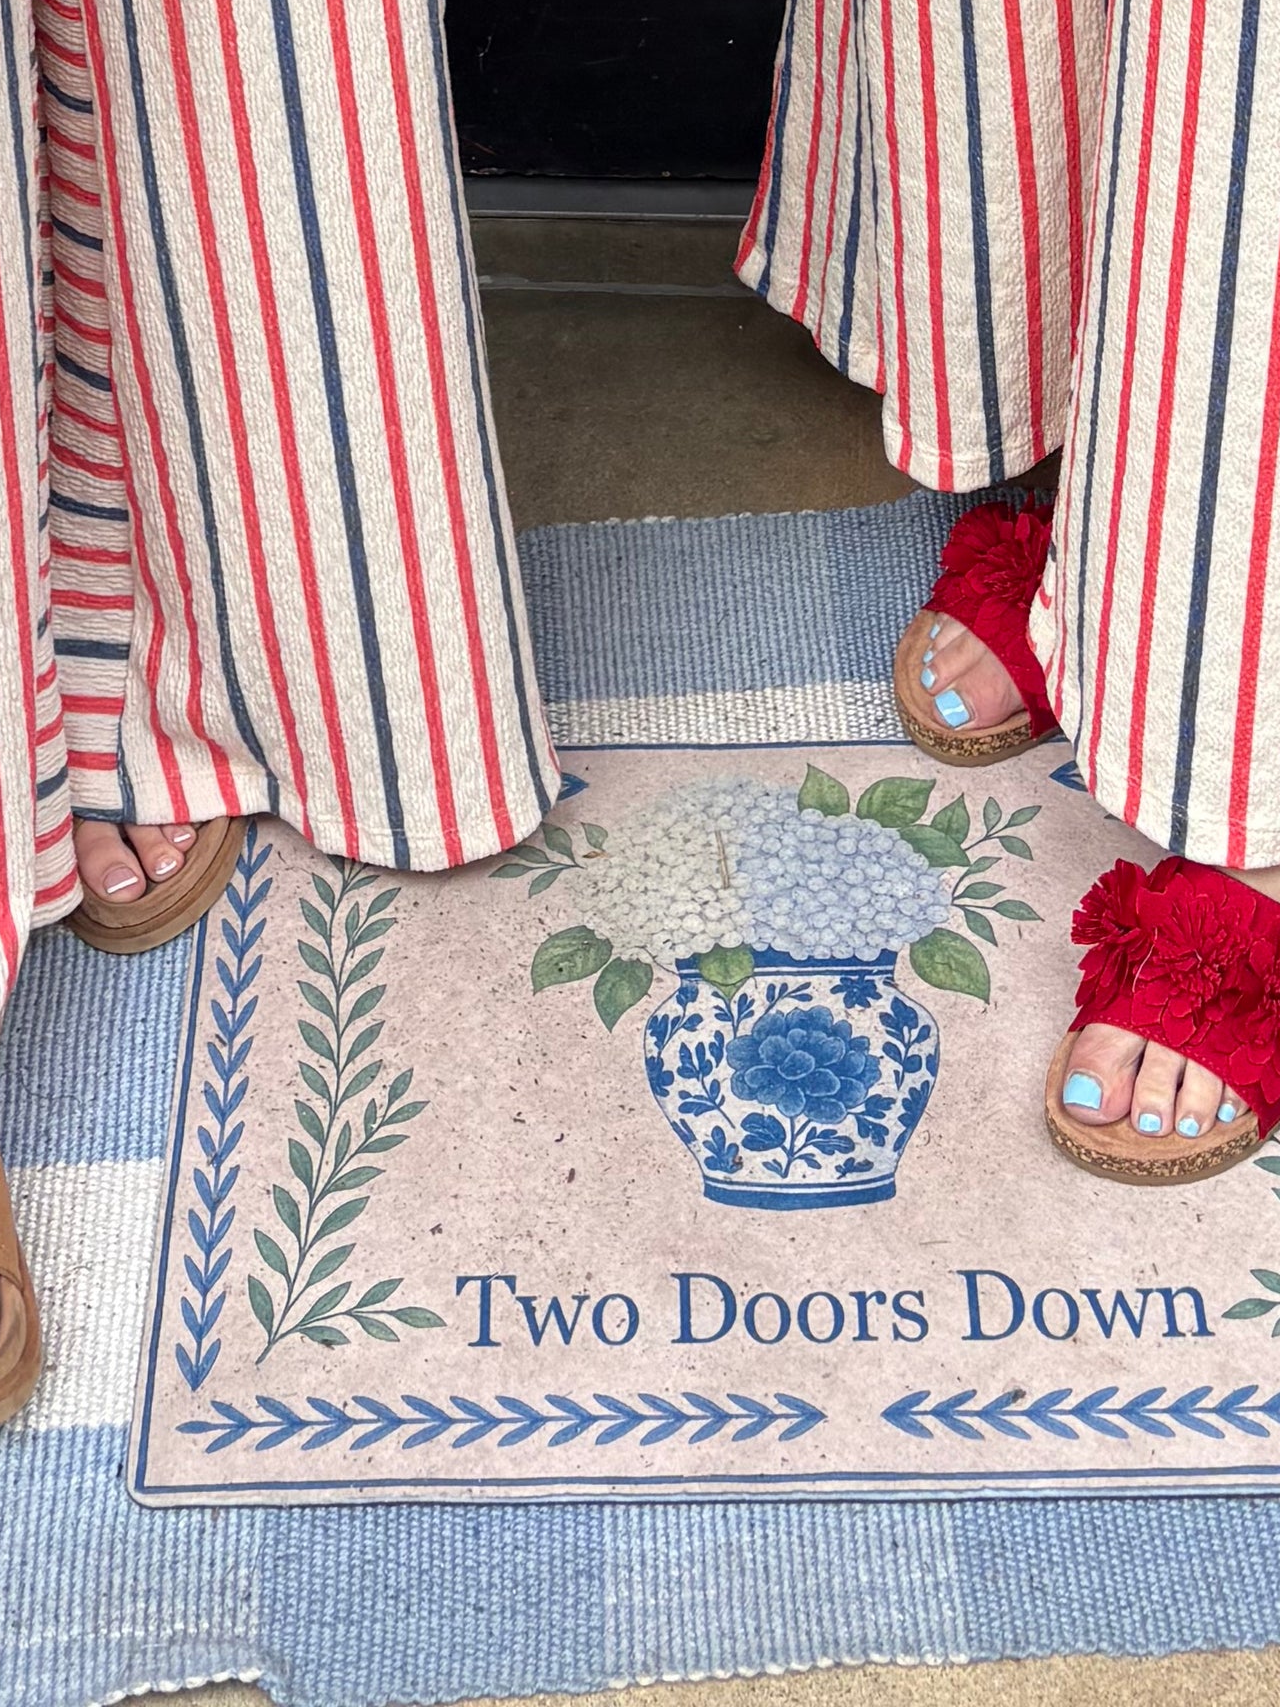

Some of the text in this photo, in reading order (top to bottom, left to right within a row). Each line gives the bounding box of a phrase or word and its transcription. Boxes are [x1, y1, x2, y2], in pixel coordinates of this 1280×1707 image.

[454, 1270, 1214, 1348] Two Doors Down
